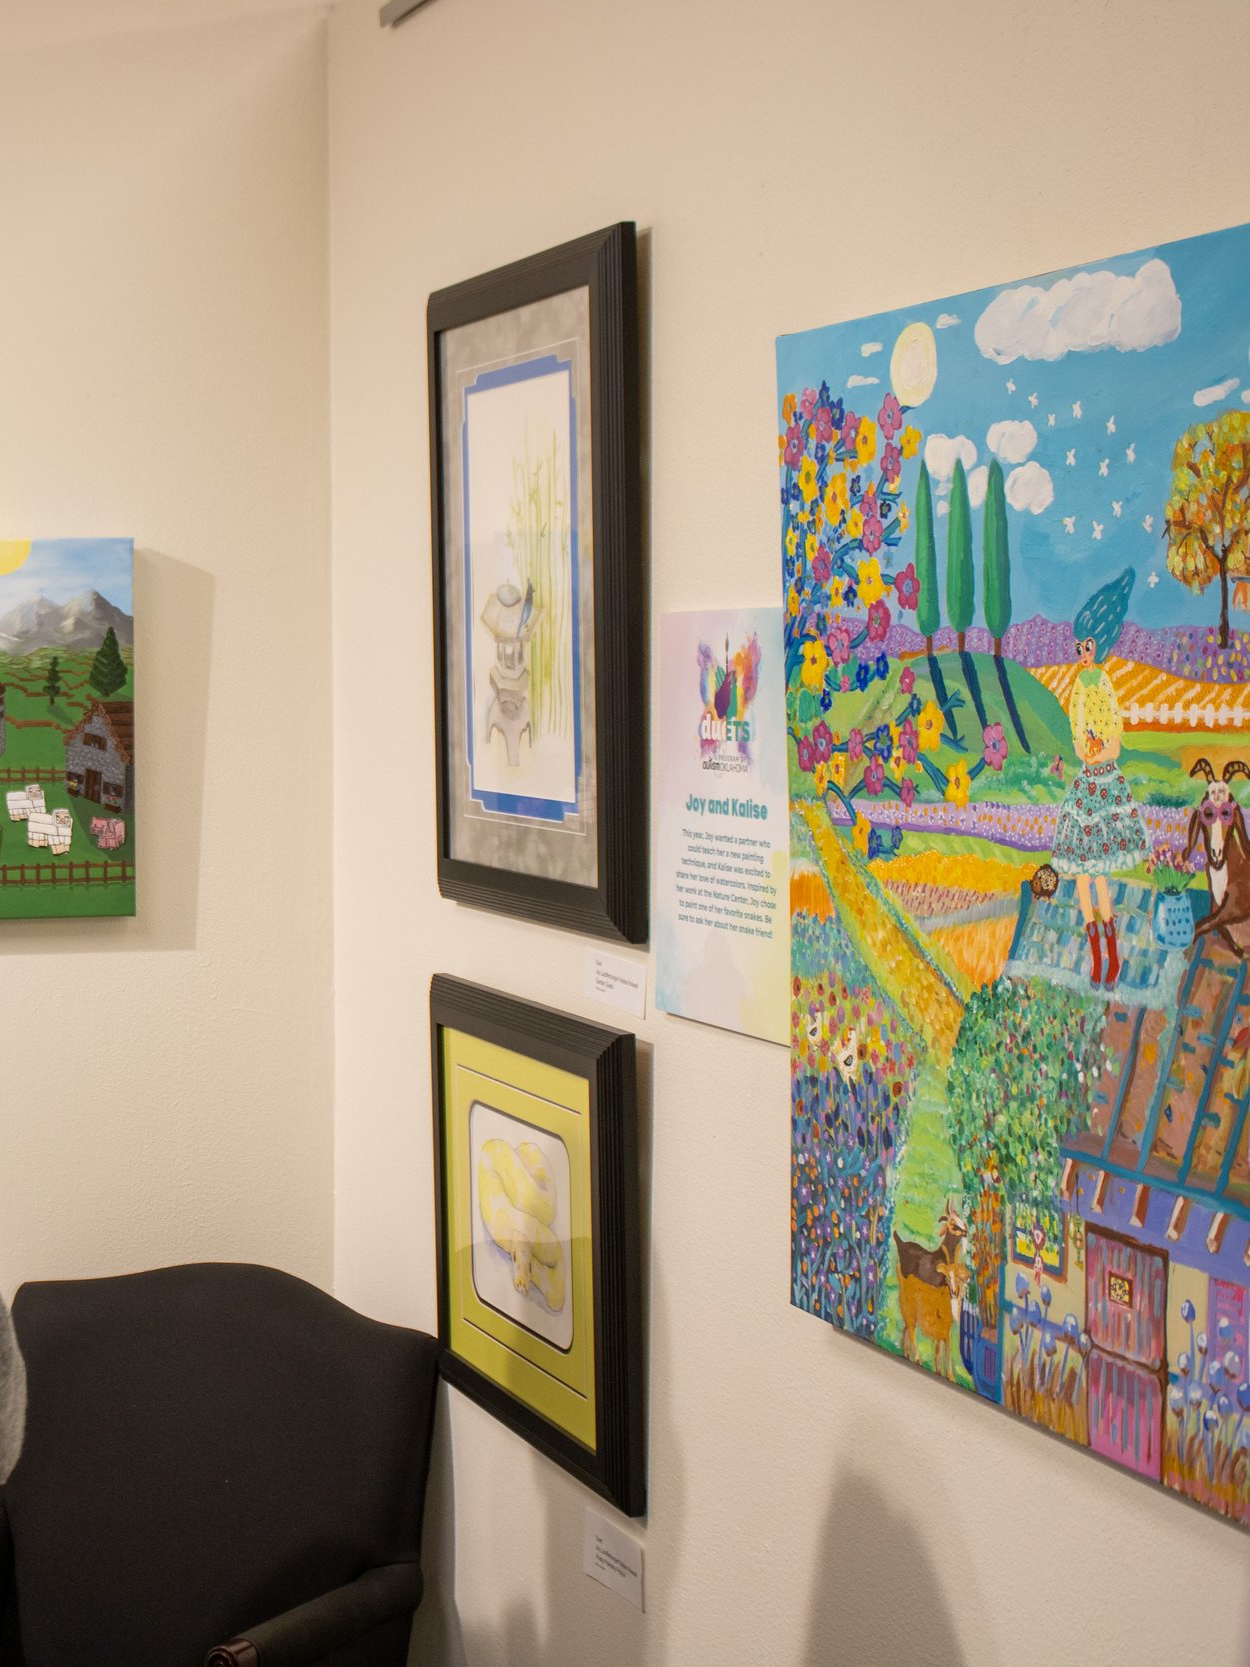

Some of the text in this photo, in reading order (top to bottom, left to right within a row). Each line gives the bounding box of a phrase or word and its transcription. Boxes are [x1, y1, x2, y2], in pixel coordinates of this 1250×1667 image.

[686, 794, 768, 820] Joy and Kalise
[682, 829, 692, 838] This
[705, 832, 714, 842] Joy
[715, 834, 734, 844] wanted
[739, 837, 758, 846] partner
[759, 840, 771, 849] who
[688, 845, 701, 853] could
[702, 846, 716, 855] teach
[717, 848, 725, 856] her
[742, 852, 764, 864] painting
[707, 862, 717, 870] and
[718, 863, 732, 872] Kalise
[745, 868, 764, 877] excited
[765, 870, 771, 878] to
[676, 870, 777, 896] share her love of watercolors. Inspired by
[685, 886, 697, 895] work
[704, 889, 712, 898] the
[713, 891, 730, 901] Nature
[750, 897, 759, 908] Joy
[760, 900, 777, 910] chose
[685, 900, 697, 909] paint
[698, 904, 707, 912] one
[708, 904, 714, 912] of
[715, 905, 723, 914] her
[724, 907, 743, 918] favorite
[744, 910, 763, 922] snakes.
[765, 915, 772, 924] Be
[678, 913, 689, 922] sure
[689, 915, 695, 923] to
[705, 918, 713, 927] her
[714, 919, 729, 929] about
[729, 921, 738, 931] her
[739, 924, 754, 935] snake
